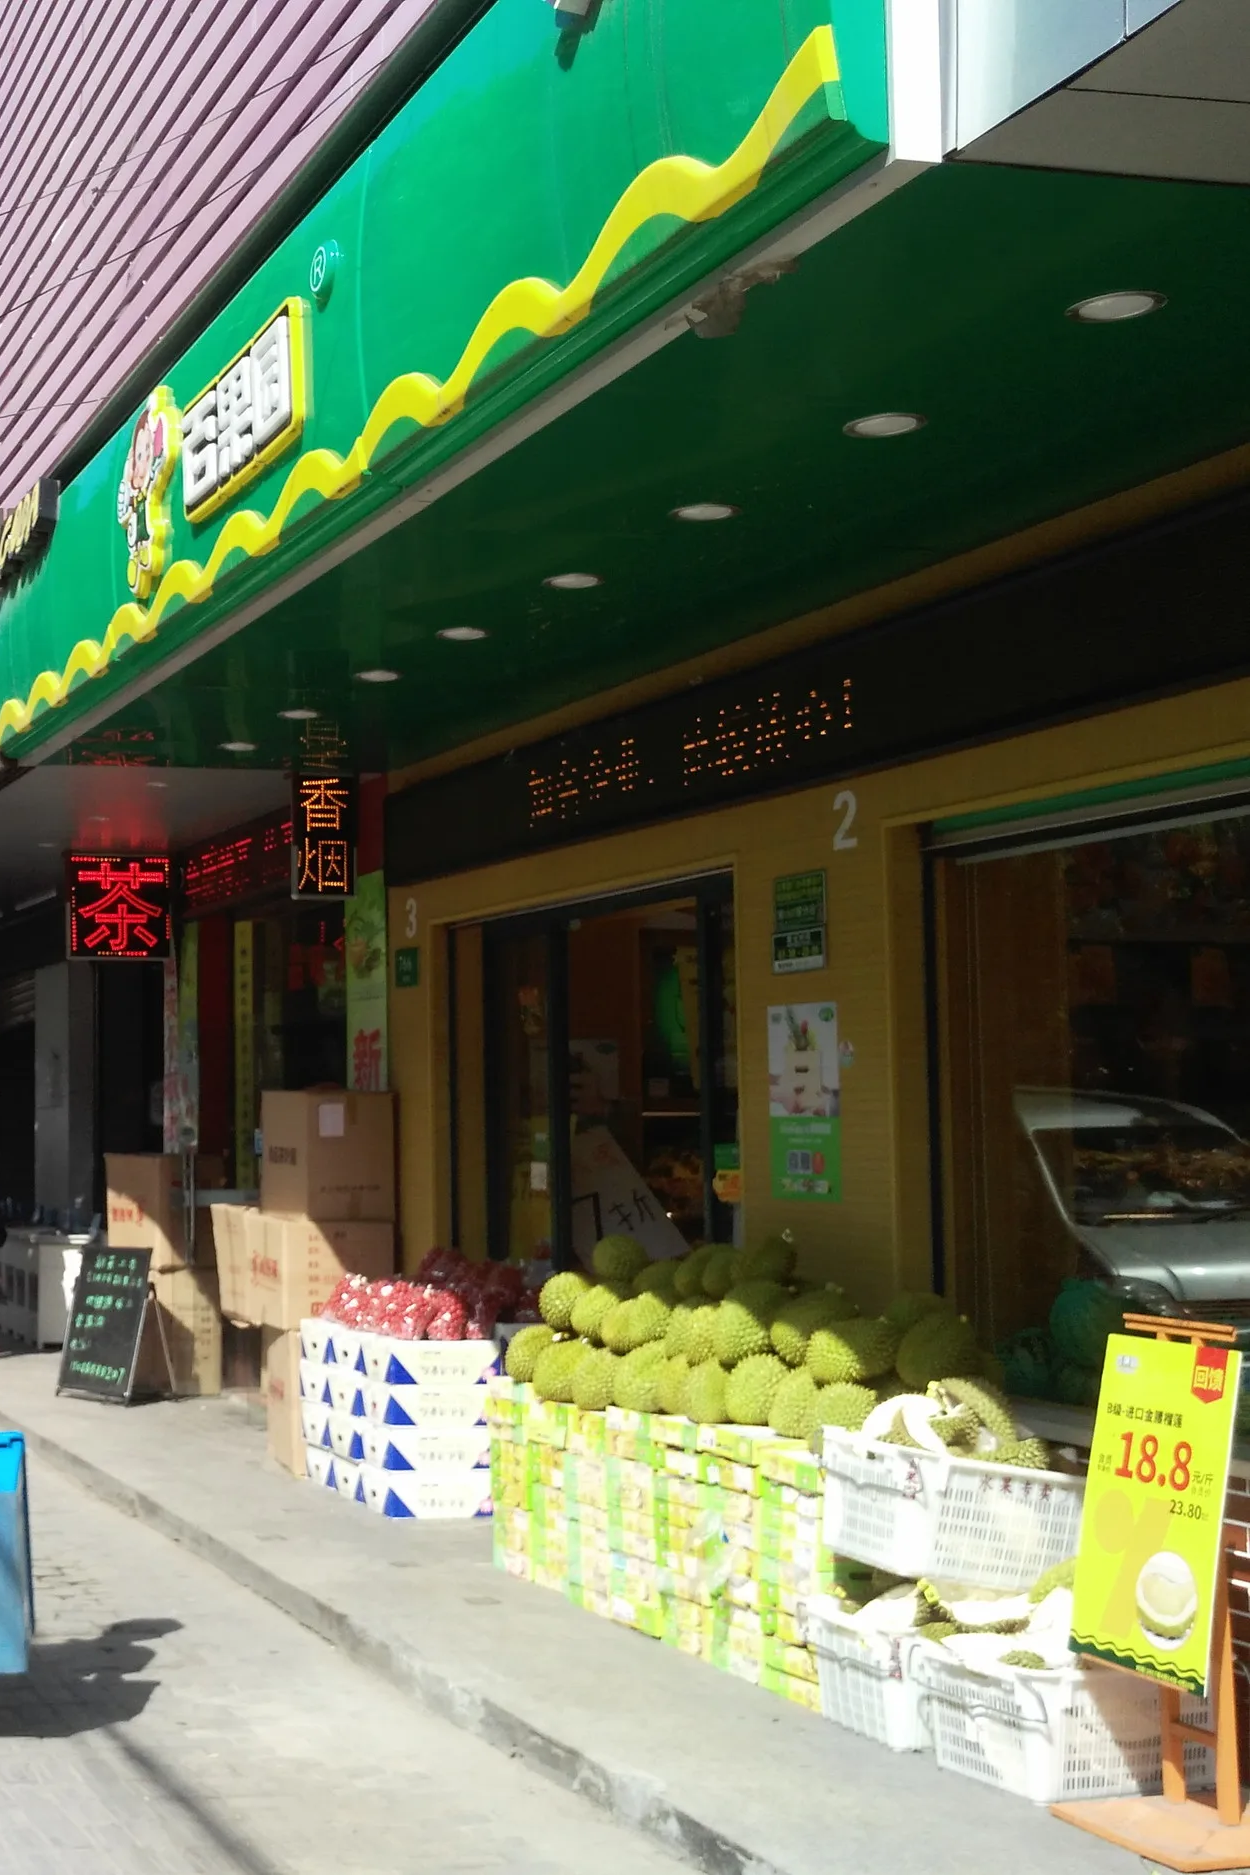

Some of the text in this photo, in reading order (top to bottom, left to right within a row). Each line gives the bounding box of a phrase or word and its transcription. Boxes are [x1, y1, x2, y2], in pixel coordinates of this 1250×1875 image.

[182, 315, 290, 507] 百果园
[297, 775, 349, 893] 香烟
[832, 789, 859, 852] 2
[77, 861, 165, 951] 茶
[405, 897, 418, 939] 3
[1193, 1365, 1224, 1392] 回馈
[1114, 1431, 1193, 1492] 18.8
[1191, 1470, 1214, 1487] 元/斤
[1169, 1499, 1202, 1521] 23.80
